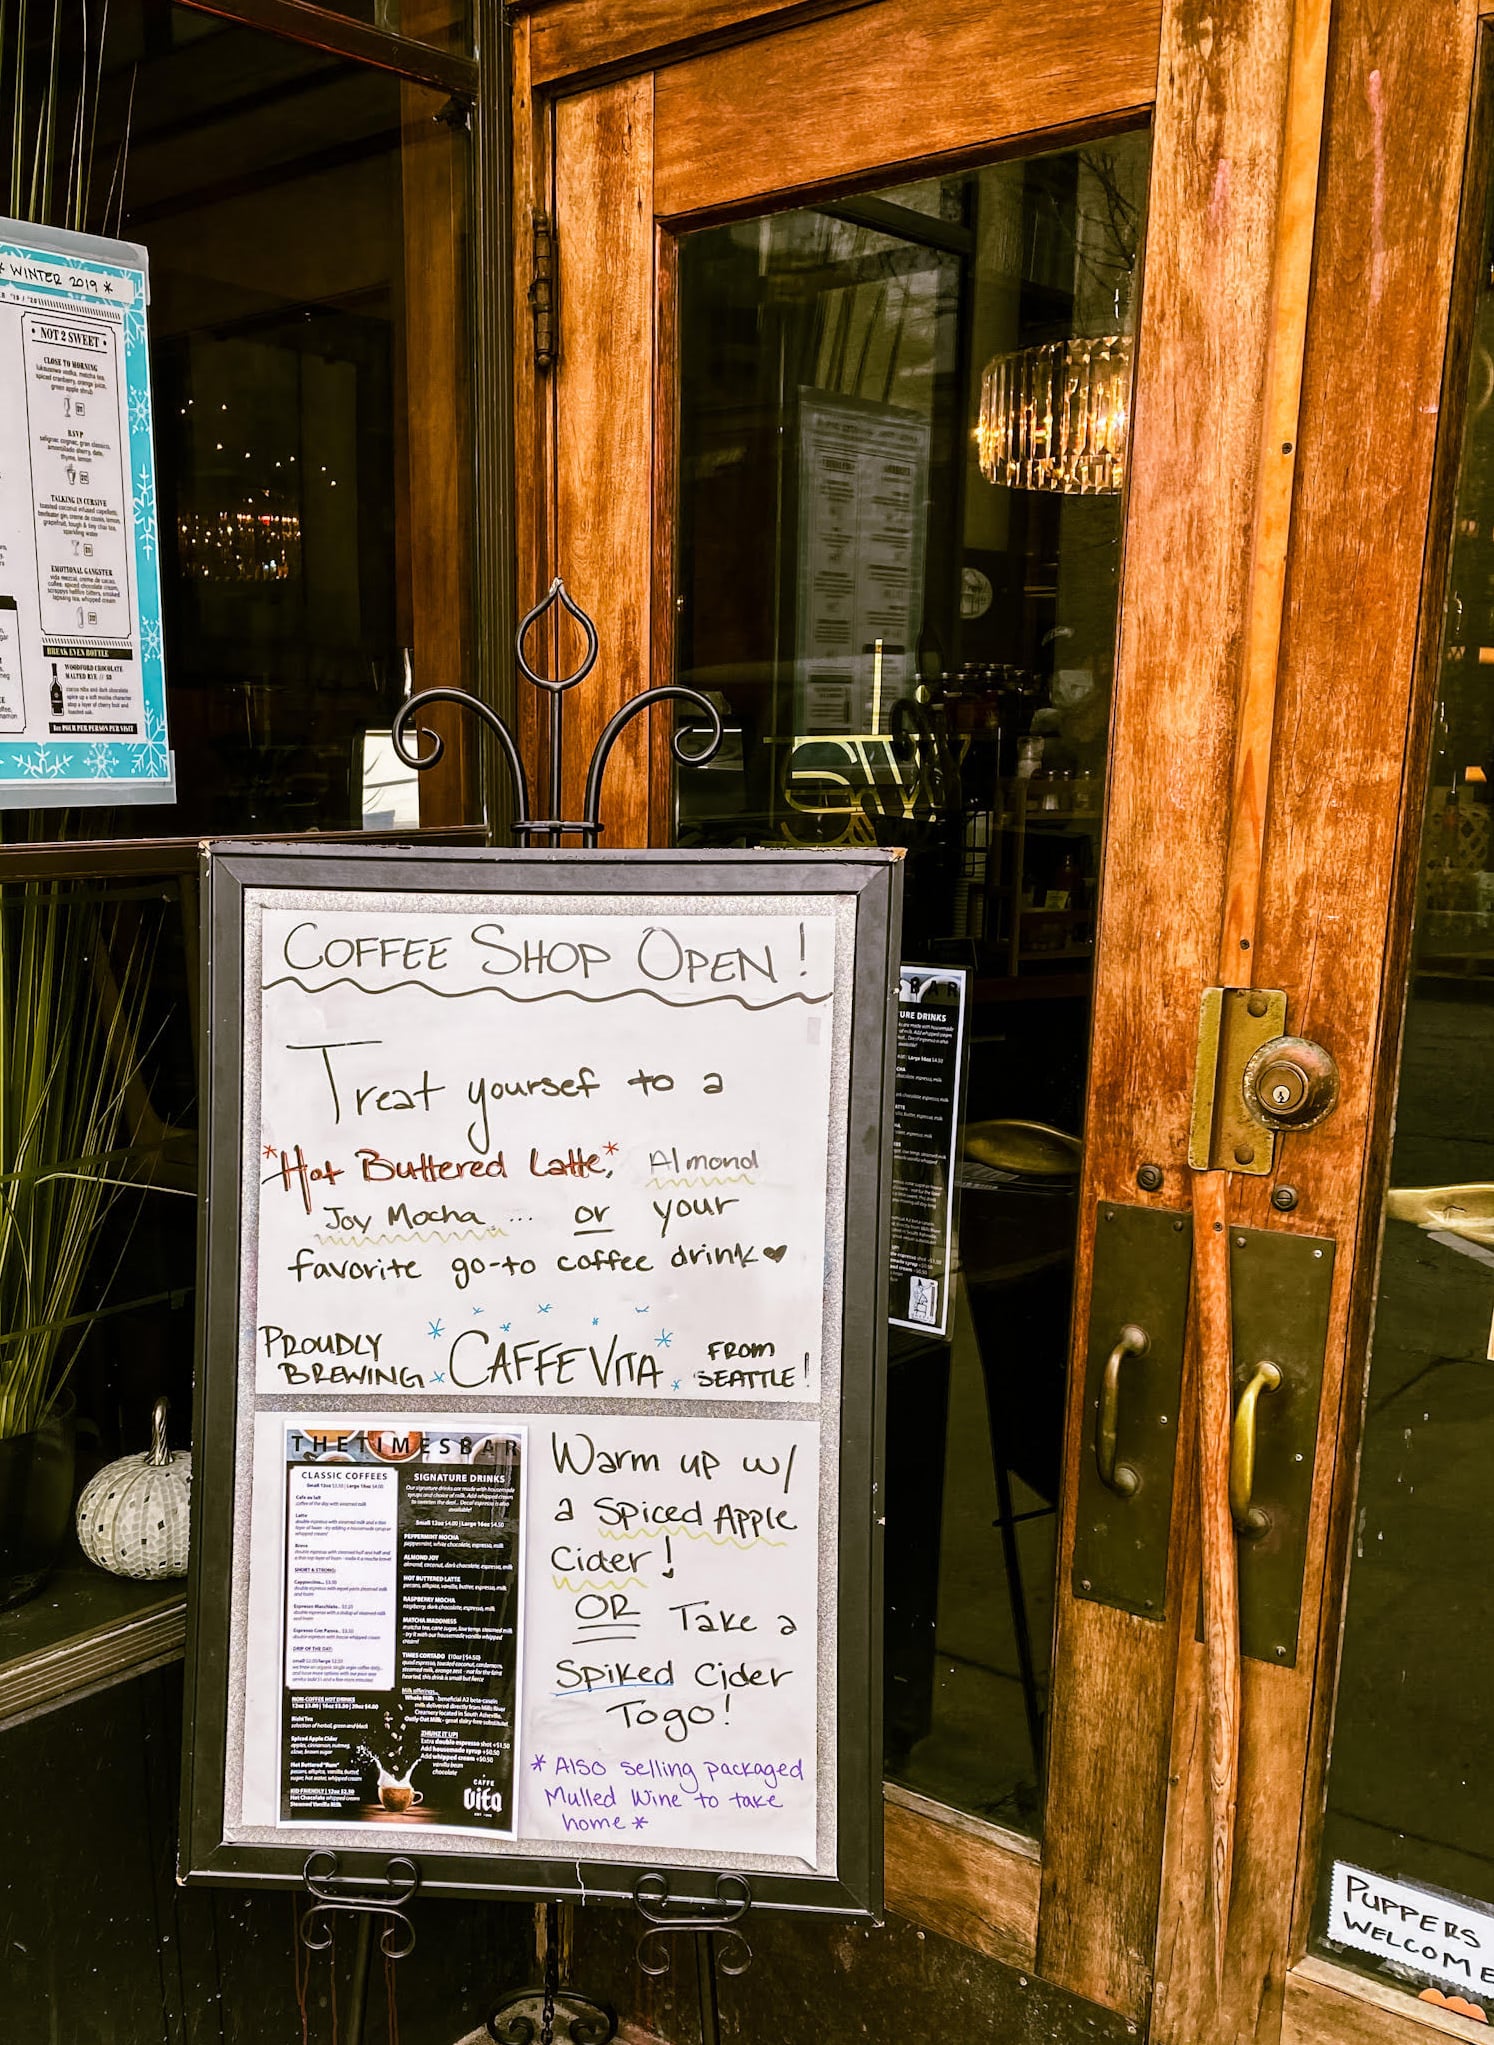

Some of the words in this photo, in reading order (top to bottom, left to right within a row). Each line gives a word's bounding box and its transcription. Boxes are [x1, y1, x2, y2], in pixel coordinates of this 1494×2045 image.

[10, 264, 62, 285] WINTER
[70, 277, 98, 292] 2019
[41, 327, 59, 340] NOT
[61, 331, 66, 340] 2
[69, 332, 99, 347] SWEET
[51, 495, 75, 503] TALKING
[51, 565, 83, 574] EMOTIONAL
[84, 568, 112, 576] GANGSTER
[86, 649, 109, 657] BOTTLE
[284, 922, 452, 971] COFFEE
[471, 924, 612, 978] SHOP
[917, 1012, 946, 1022] DRINKS
[286, 1040, 446, 1124] Treat
[468, 1067, 602, 1154] yoursef
[628, 1068, 674, 1096] to
[704, 1073, 724, 1095] a
[355, 1147, 508, 1182] Buttered
[648, 1149, 759, 1173] Almond
[323, 1207, 372, 1234] Joy
[574, 1203, 611, 1225] or
[653, 1197, 740, 1238] your
[287, 1248, 422, 1284] favorite
[451, 1255, 536, 1288] go-to
[557, 1248, 654, 1273] coffee
[670, 1243, 761, 1268] drink
[258, 1325, 383, 1362] PROUDLY
[278, 1363, 426, 1388] BREWING
[448, 1330, 586, 1389] CAFFE
[590, 1334, 664, 1388] VITA
[414, 1473, 467, 1482] SIGNATURE
[470, 1475, 505, 1483] DRINKS
[552, 1432, 660, 1476] Warm
[680, 1450, 720, 1479] up
[742, 1444, 797, 1494] w/
[554, 1497, 575, 1523] a
[594, 1496, 702, 1526] Spiced
[714, 1503, 798, 1538] Apple
[575, 1595, 640, 1620] OR
[669, 1601, 758, 1632] Take
[778, 1615, 797, 1635] a
[556, 1660, 675, 1691] Spiked
[695, 1662, 794, 1690] Cider
[554, 1756, 606, 1776] Also
[620, 1756, 696, 1794] selling
[703, 1758, 803, 1789] packaged
[545, 1786, 616, 1807] Mulled
[631, 1790, 680, 1808] Wine
[695, 1790, 719, 1808] to
[729, 1792, 784, 1808] take
[562, 1814, 626, 1831] home
[1347, 1875, 1481, 1948] PUPPERS
[1344, 1911, 1494, 1983] WELCOME
